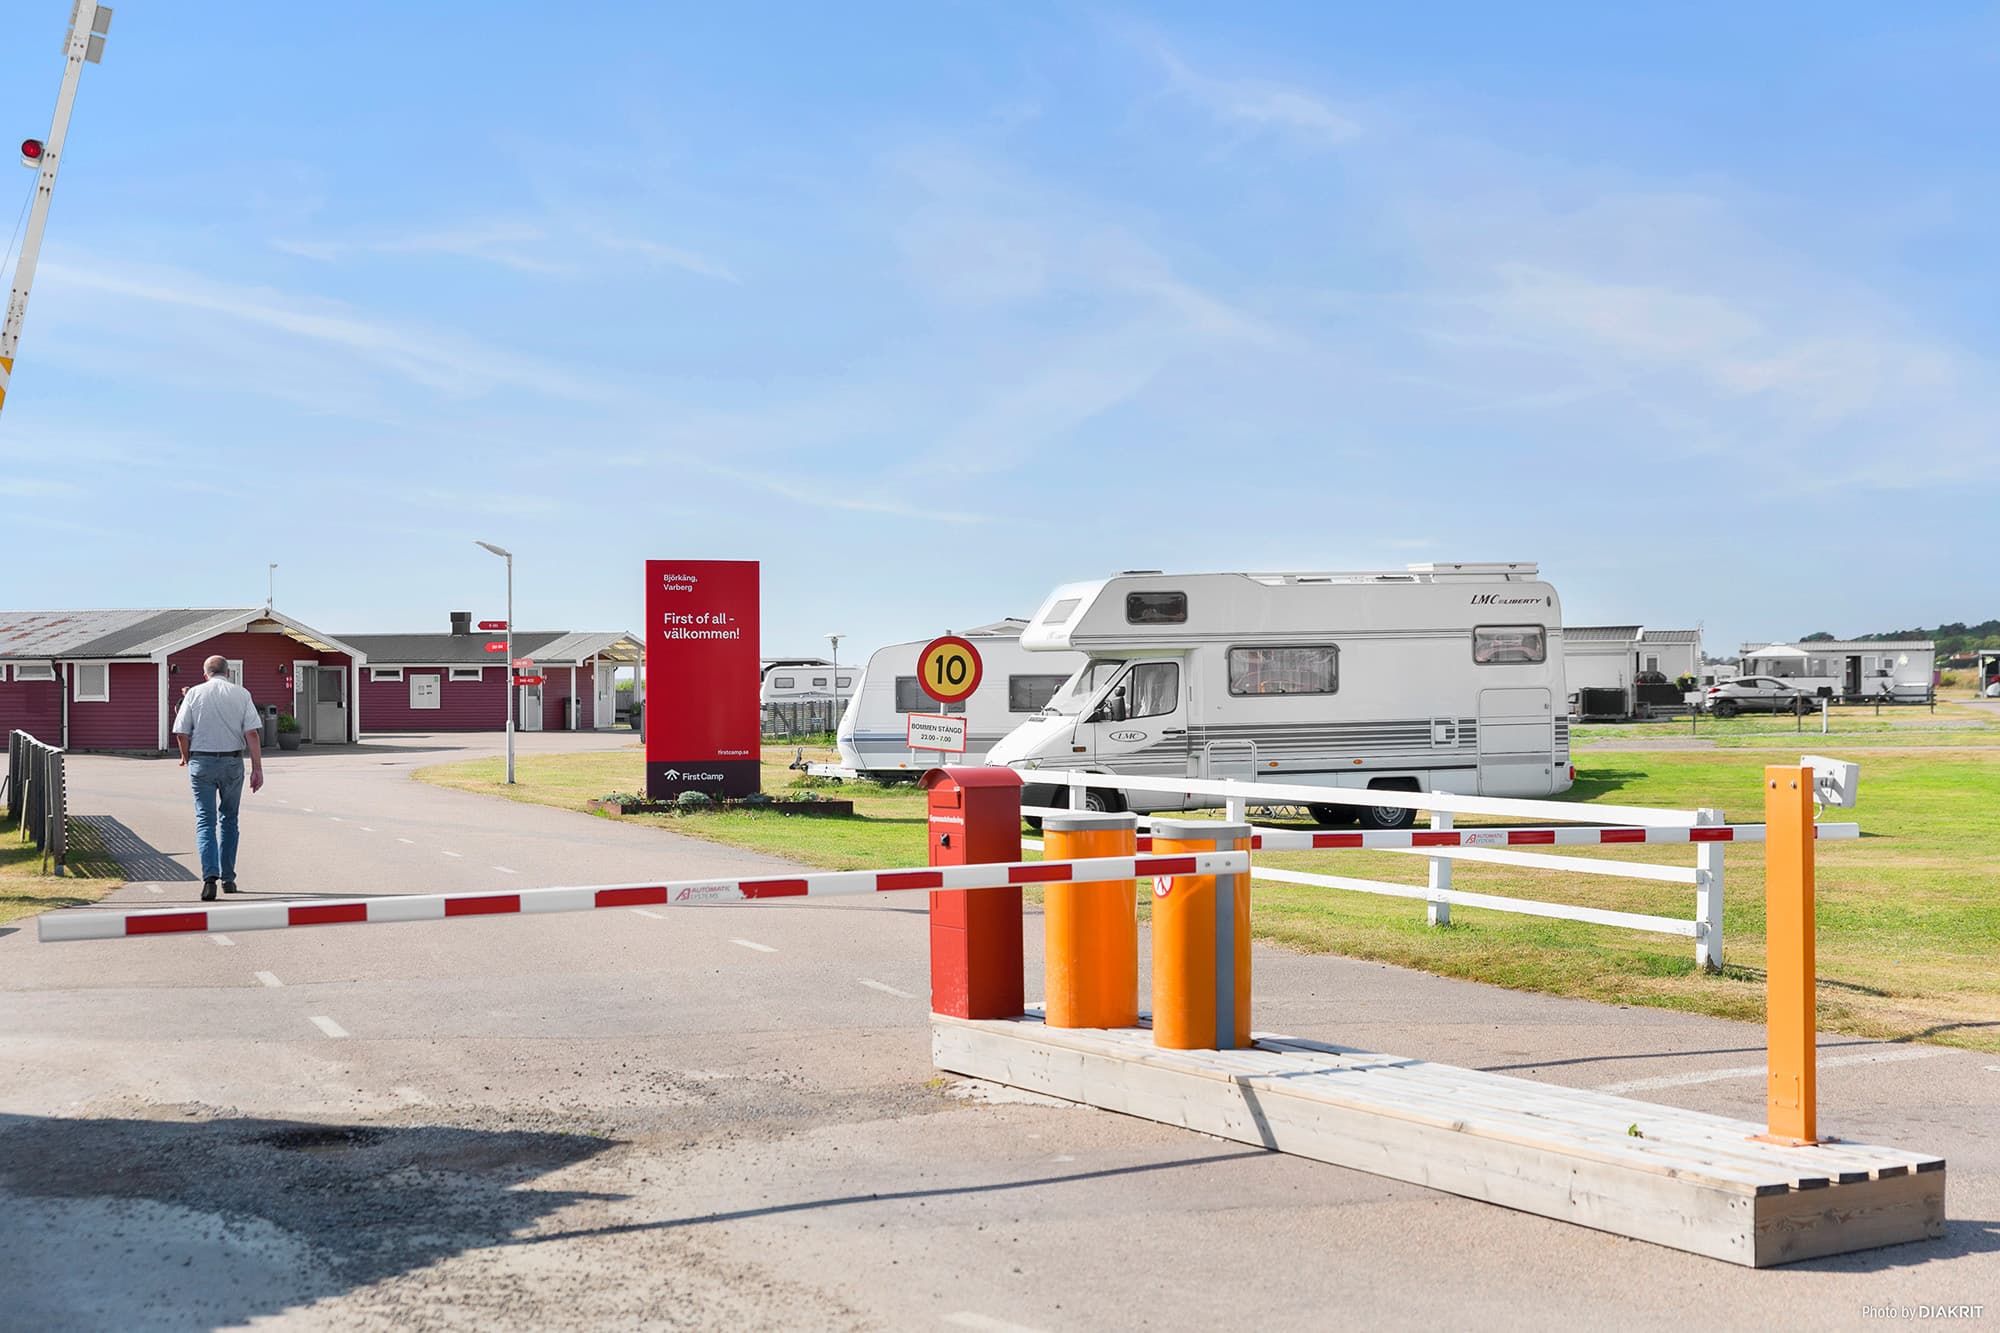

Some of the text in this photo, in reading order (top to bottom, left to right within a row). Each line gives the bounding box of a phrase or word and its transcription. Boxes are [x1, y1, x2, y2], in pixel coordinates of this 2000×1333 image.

[663, 583, 693, 592] Varberg
[1470, 594, 1501, 605] LMC
[664, 612, 694, 624] First
[696, 612, 710, 624] of
[711, 612, 727, 624] all
[663, 627, 740, 640] välkommen!
[935, 654, 967, 686] 10
[911, 723, 937, 731] BOMMEN
[690, 885, 731, 894] AUTOMATIC
